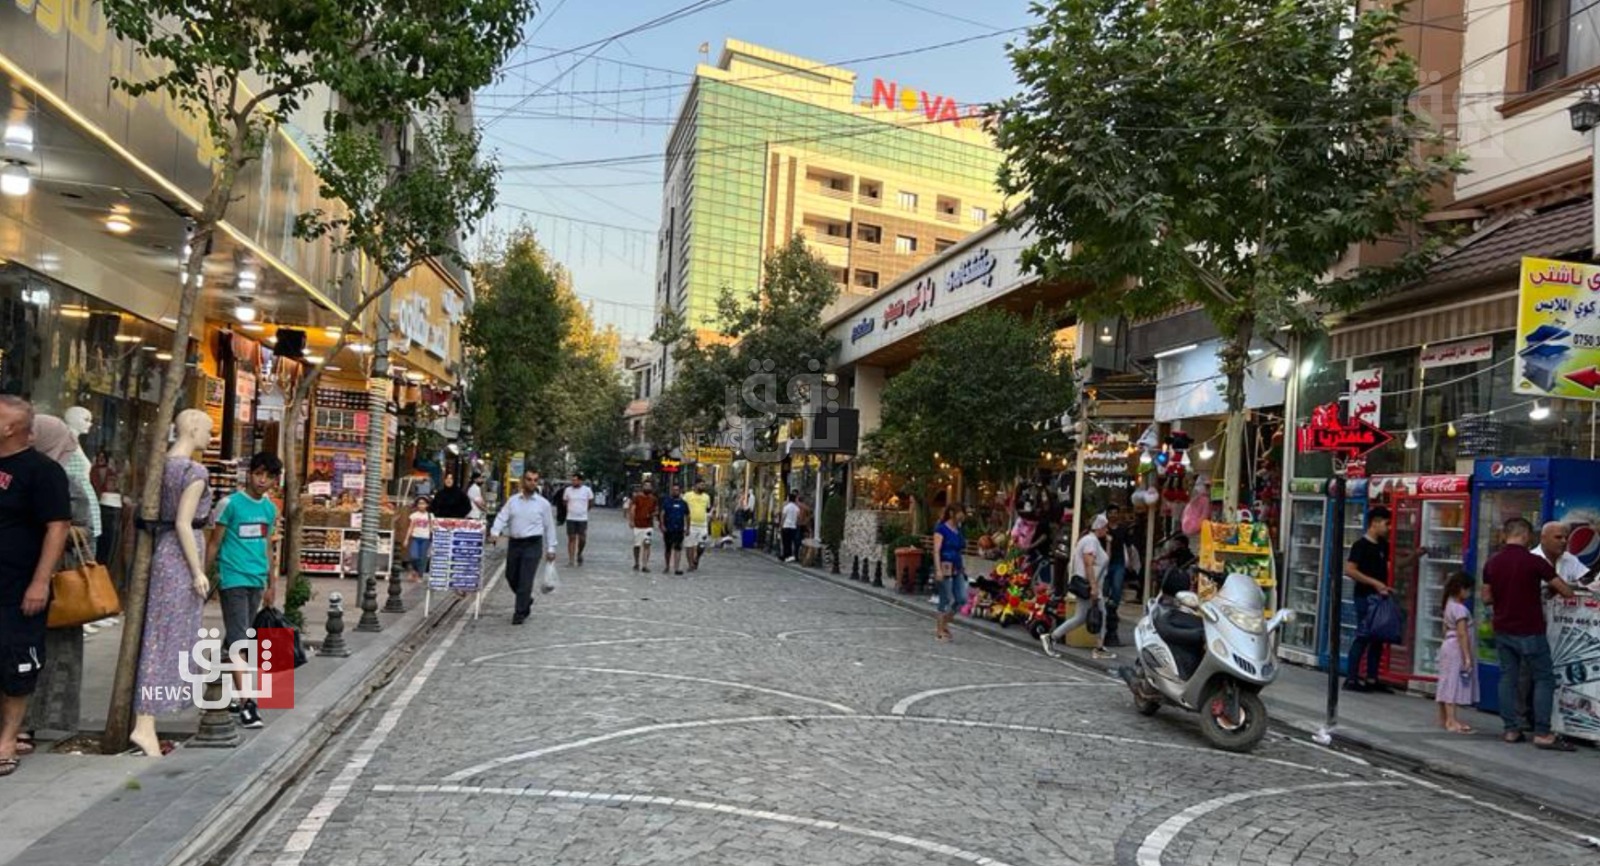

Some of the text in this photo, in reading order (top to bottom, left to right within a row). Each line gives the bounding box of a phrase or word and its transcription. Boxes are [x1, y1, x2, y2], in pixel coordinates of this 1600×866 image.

[873, 77, 961, 128] NOVA
[1573, 333, 1594, 346] 0750
[1503, 464, 1530, 477] pepsi
